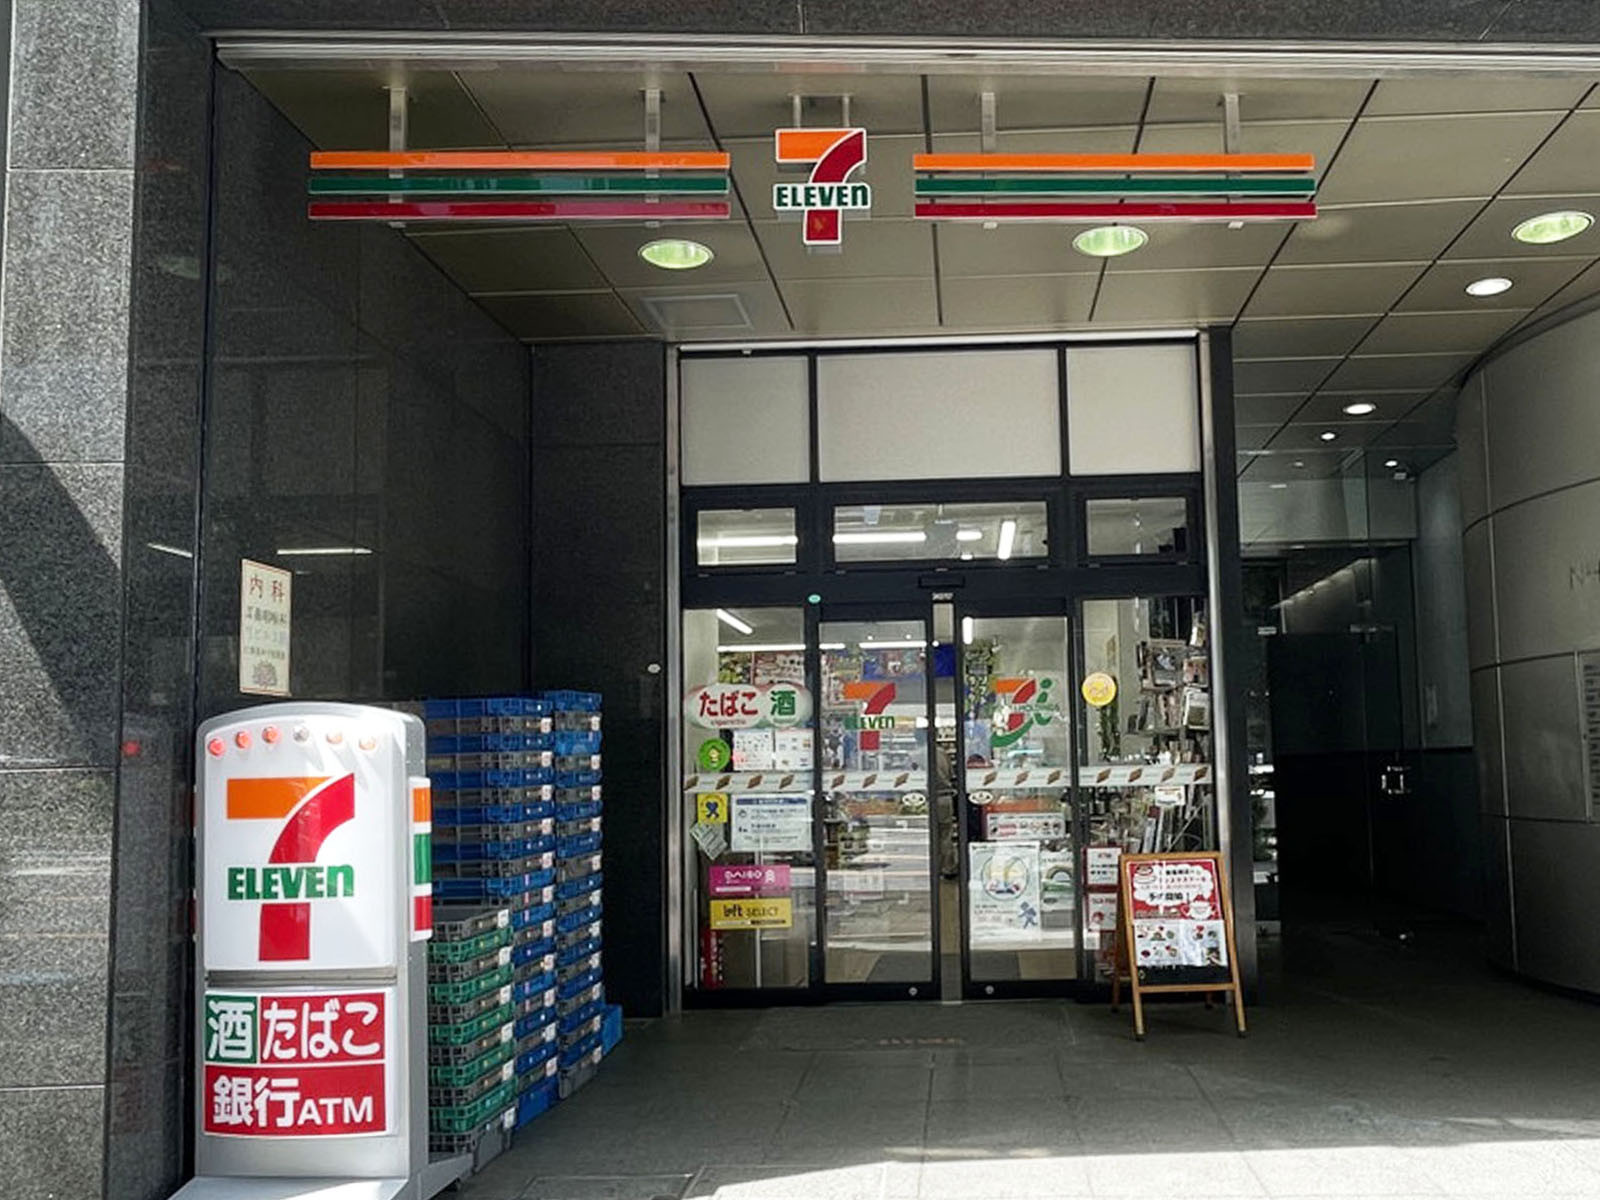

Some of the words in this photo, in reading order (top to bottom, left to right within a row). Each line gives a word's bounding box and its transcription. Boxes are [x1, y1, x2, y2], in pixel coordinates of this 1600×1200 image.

[778, 131, 864, 241] 7
[700, 690, 758, 717] たばこ
[770, 690, 796, 715] 酒
[227, 773, 355, 961] 7
[208, 1000, 255, 1058] 酒
[263, 998, 381, 1059] たばこ
[213, 1075, 373, 1127] 銀行ATM
